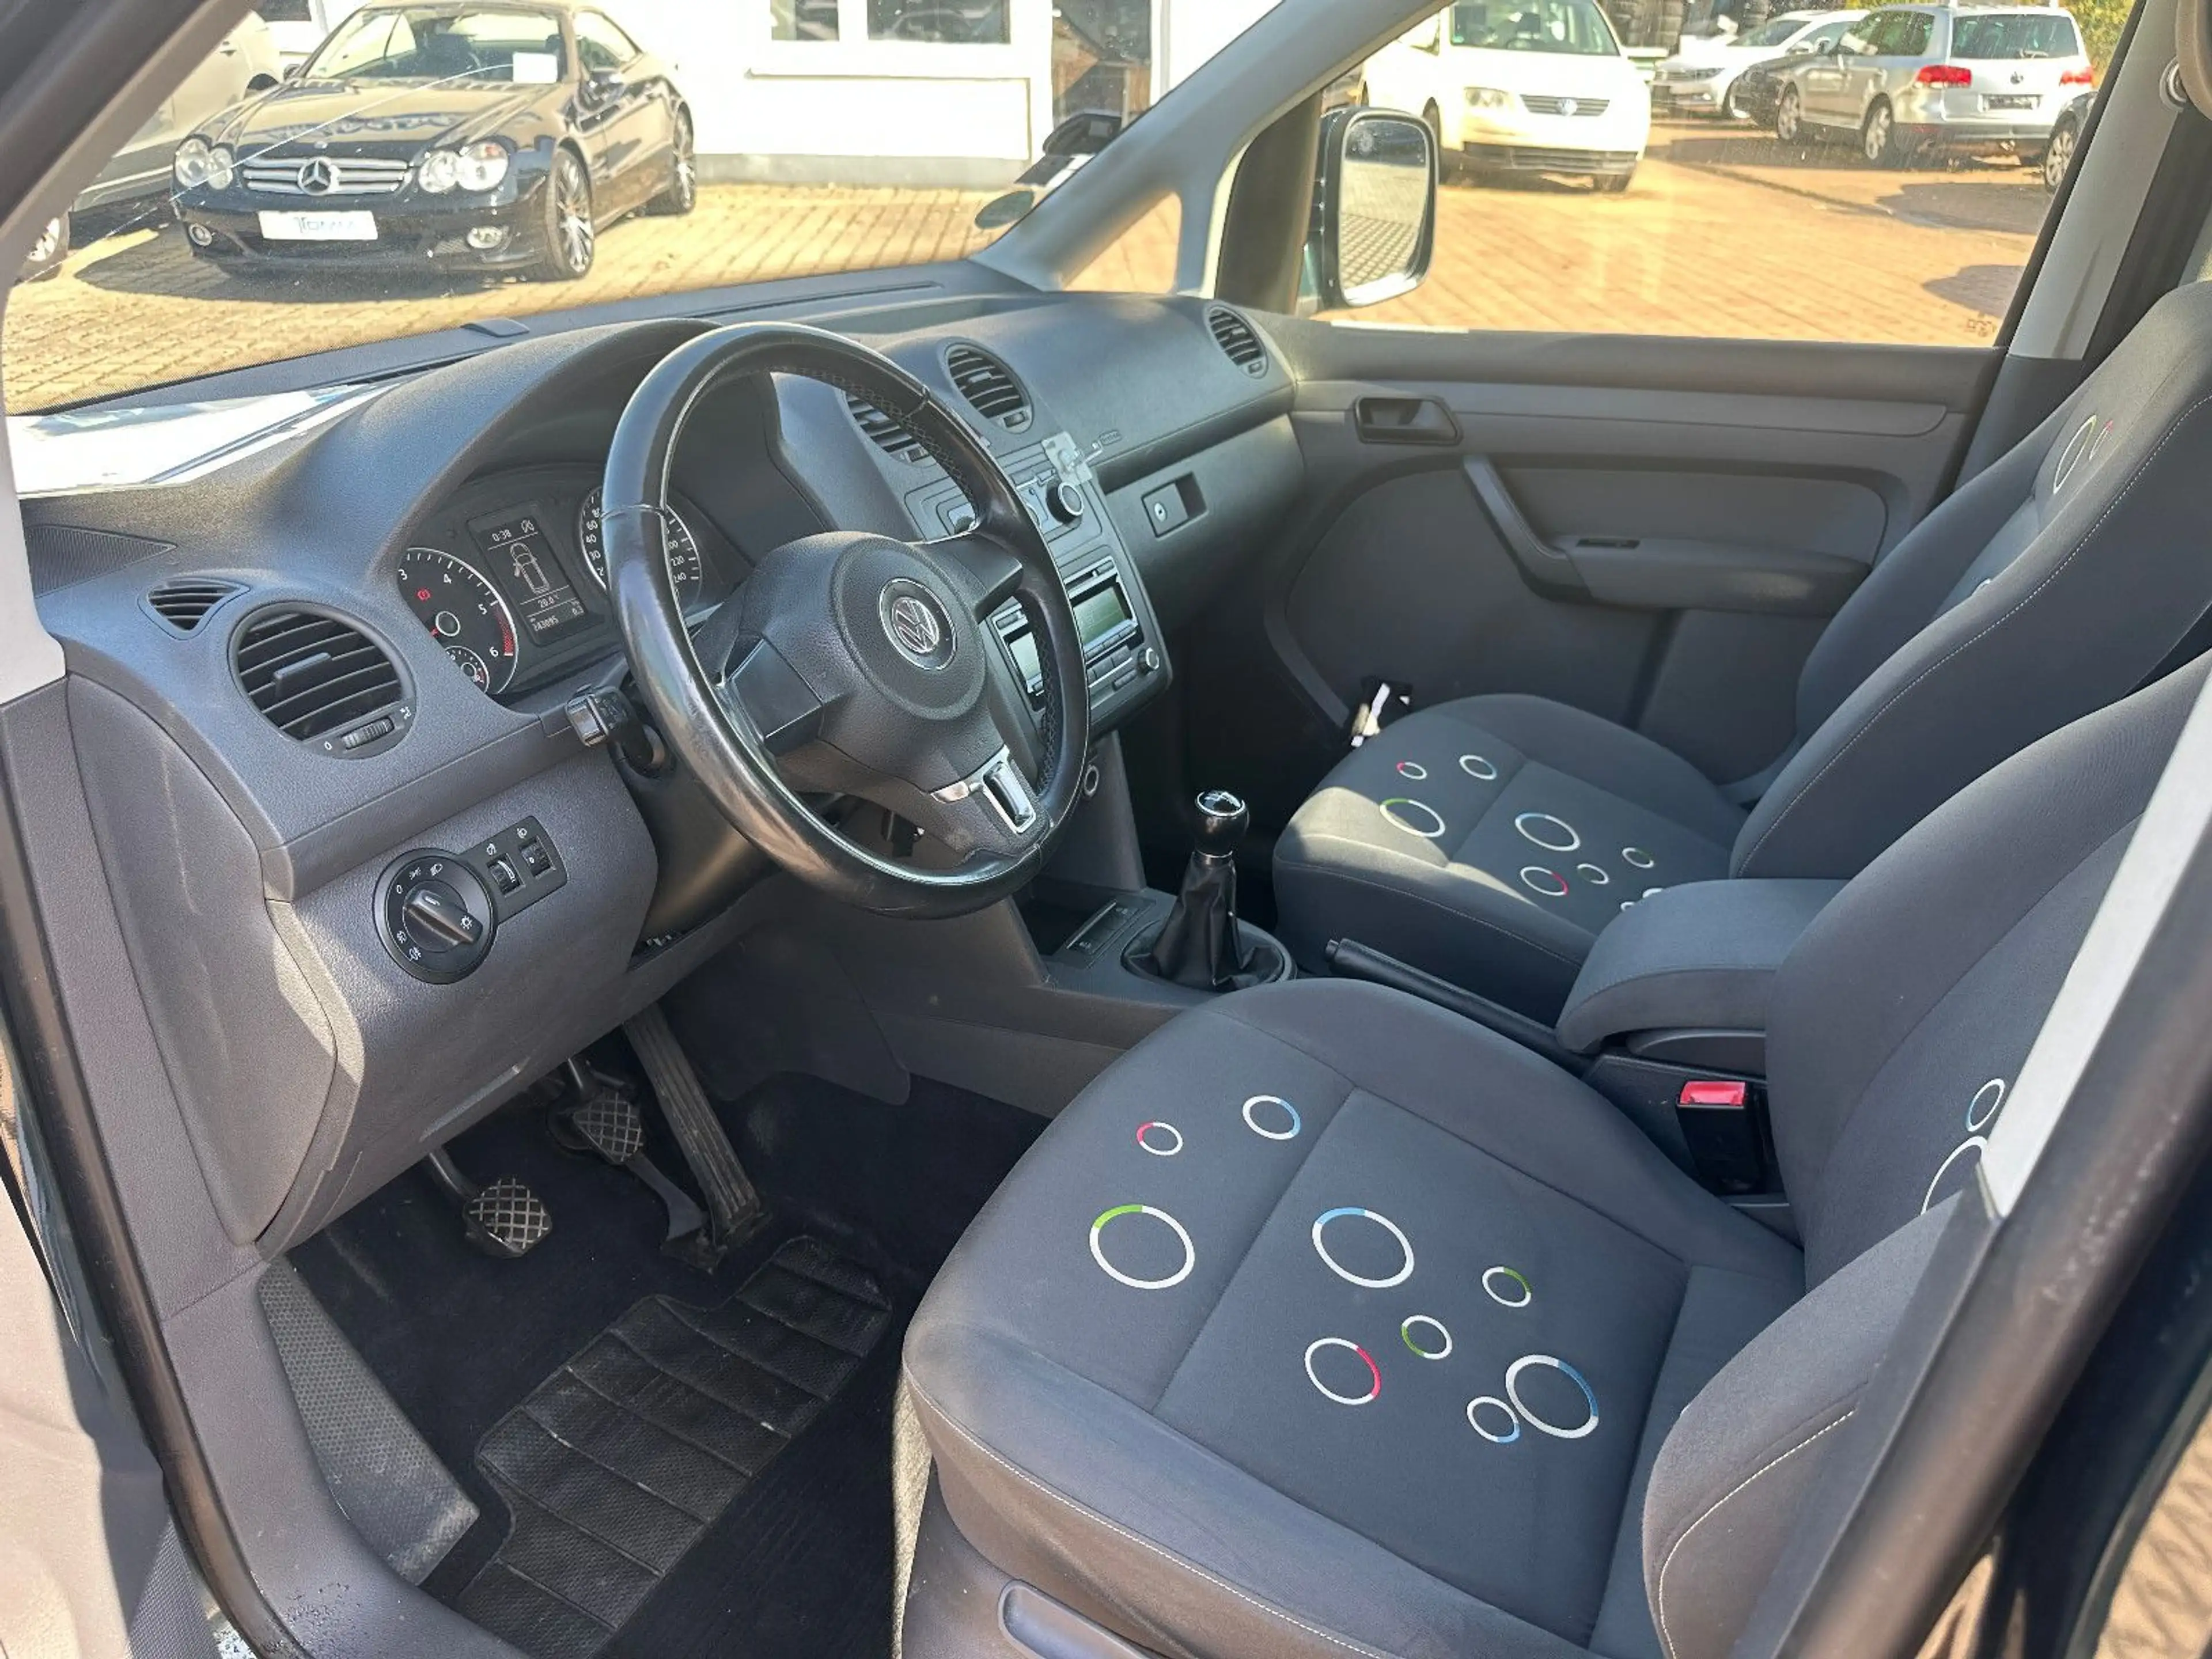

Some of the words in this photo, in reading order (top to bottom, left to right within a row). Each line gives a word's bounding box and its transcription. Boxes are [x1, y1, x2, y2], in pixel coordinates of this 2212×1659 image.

[398, 569, 407, 580] 3
[443, 573, 452, 584] 4
[478, 604, 487, 615] 5
[892, 596, 940, 653] VW
[489, 646, 499, 657] 6
